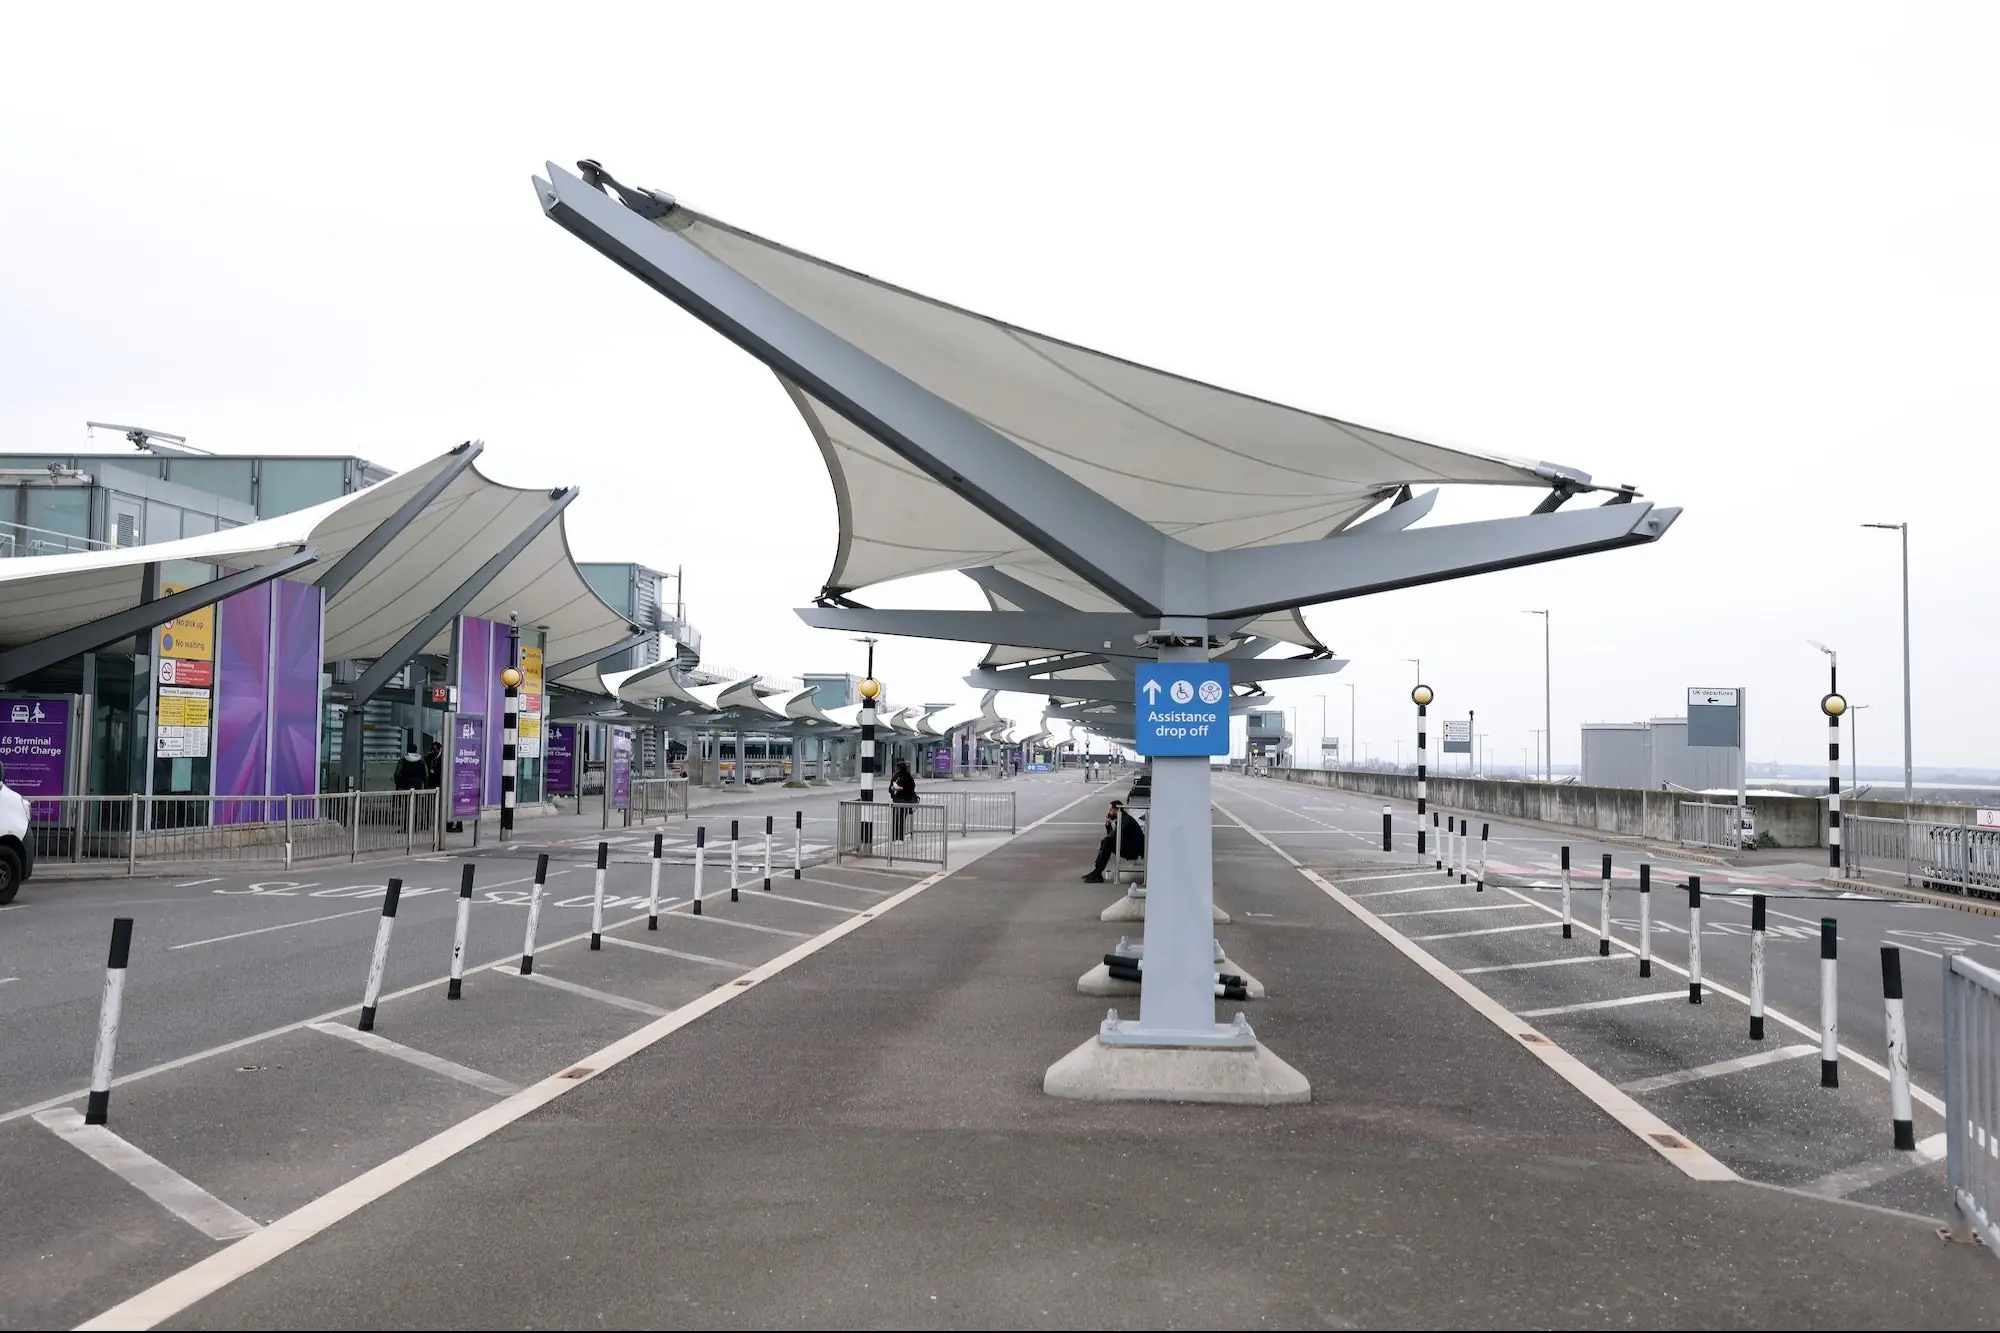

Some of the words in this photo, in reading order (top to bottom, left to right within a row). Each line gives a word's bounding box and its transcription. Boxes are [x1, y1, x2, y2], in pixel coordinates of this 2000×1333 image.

[176, 618, 184, 626] No
[185, 619, 196, 628] pick
[197, 621, 204, 630] up
[175, 639, 184, 647] No
[184, 640, 205, 652] waiting
[434, 689, 445, 697] 19
[1148, 711, 1216, 722] Assistance
[1156, 725, 1187, 739] drop
[1189, 725, 1209, 737] off
[2, 736, 12, 744] £6
[14, 736, 52, 746] Terminal
[0, 746, 29, 756] op-Off
[30, 746, 62, 757] Charge
[212, 881, 450, 898] SLOW
[456, 891, 680, 909] SLOW
